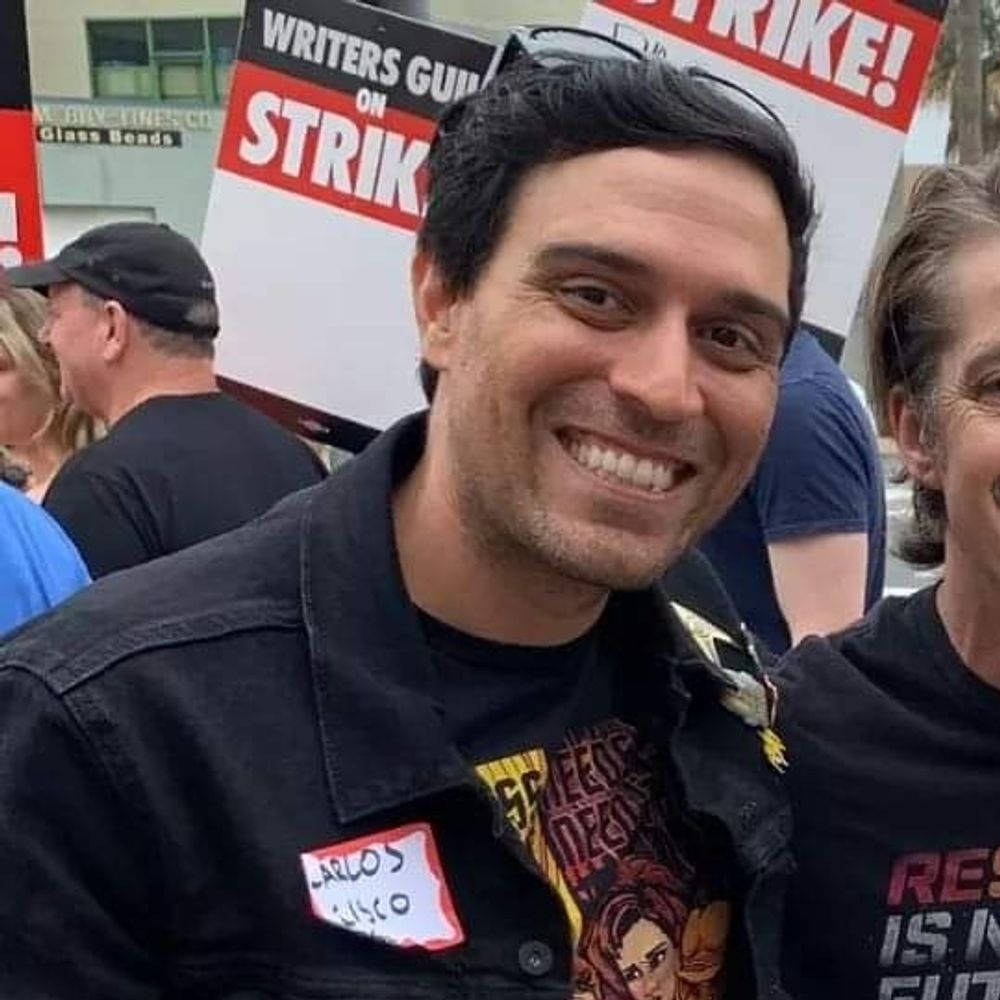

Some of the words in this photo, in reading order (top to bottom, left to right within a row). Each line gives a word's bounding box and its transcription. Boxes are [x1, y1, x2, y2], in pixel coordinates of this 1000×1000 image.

[263, 8, 401, 86] WRITERS
[633, 0, 914, 108] RIKE!
[355, 88, 387, 118] ON
[39, 127, 101, 143] Glass
[108, 129, 174, 147] Beads
[239, 91, 431, 218] STRIK
[880, 911, 953, 967] IS
